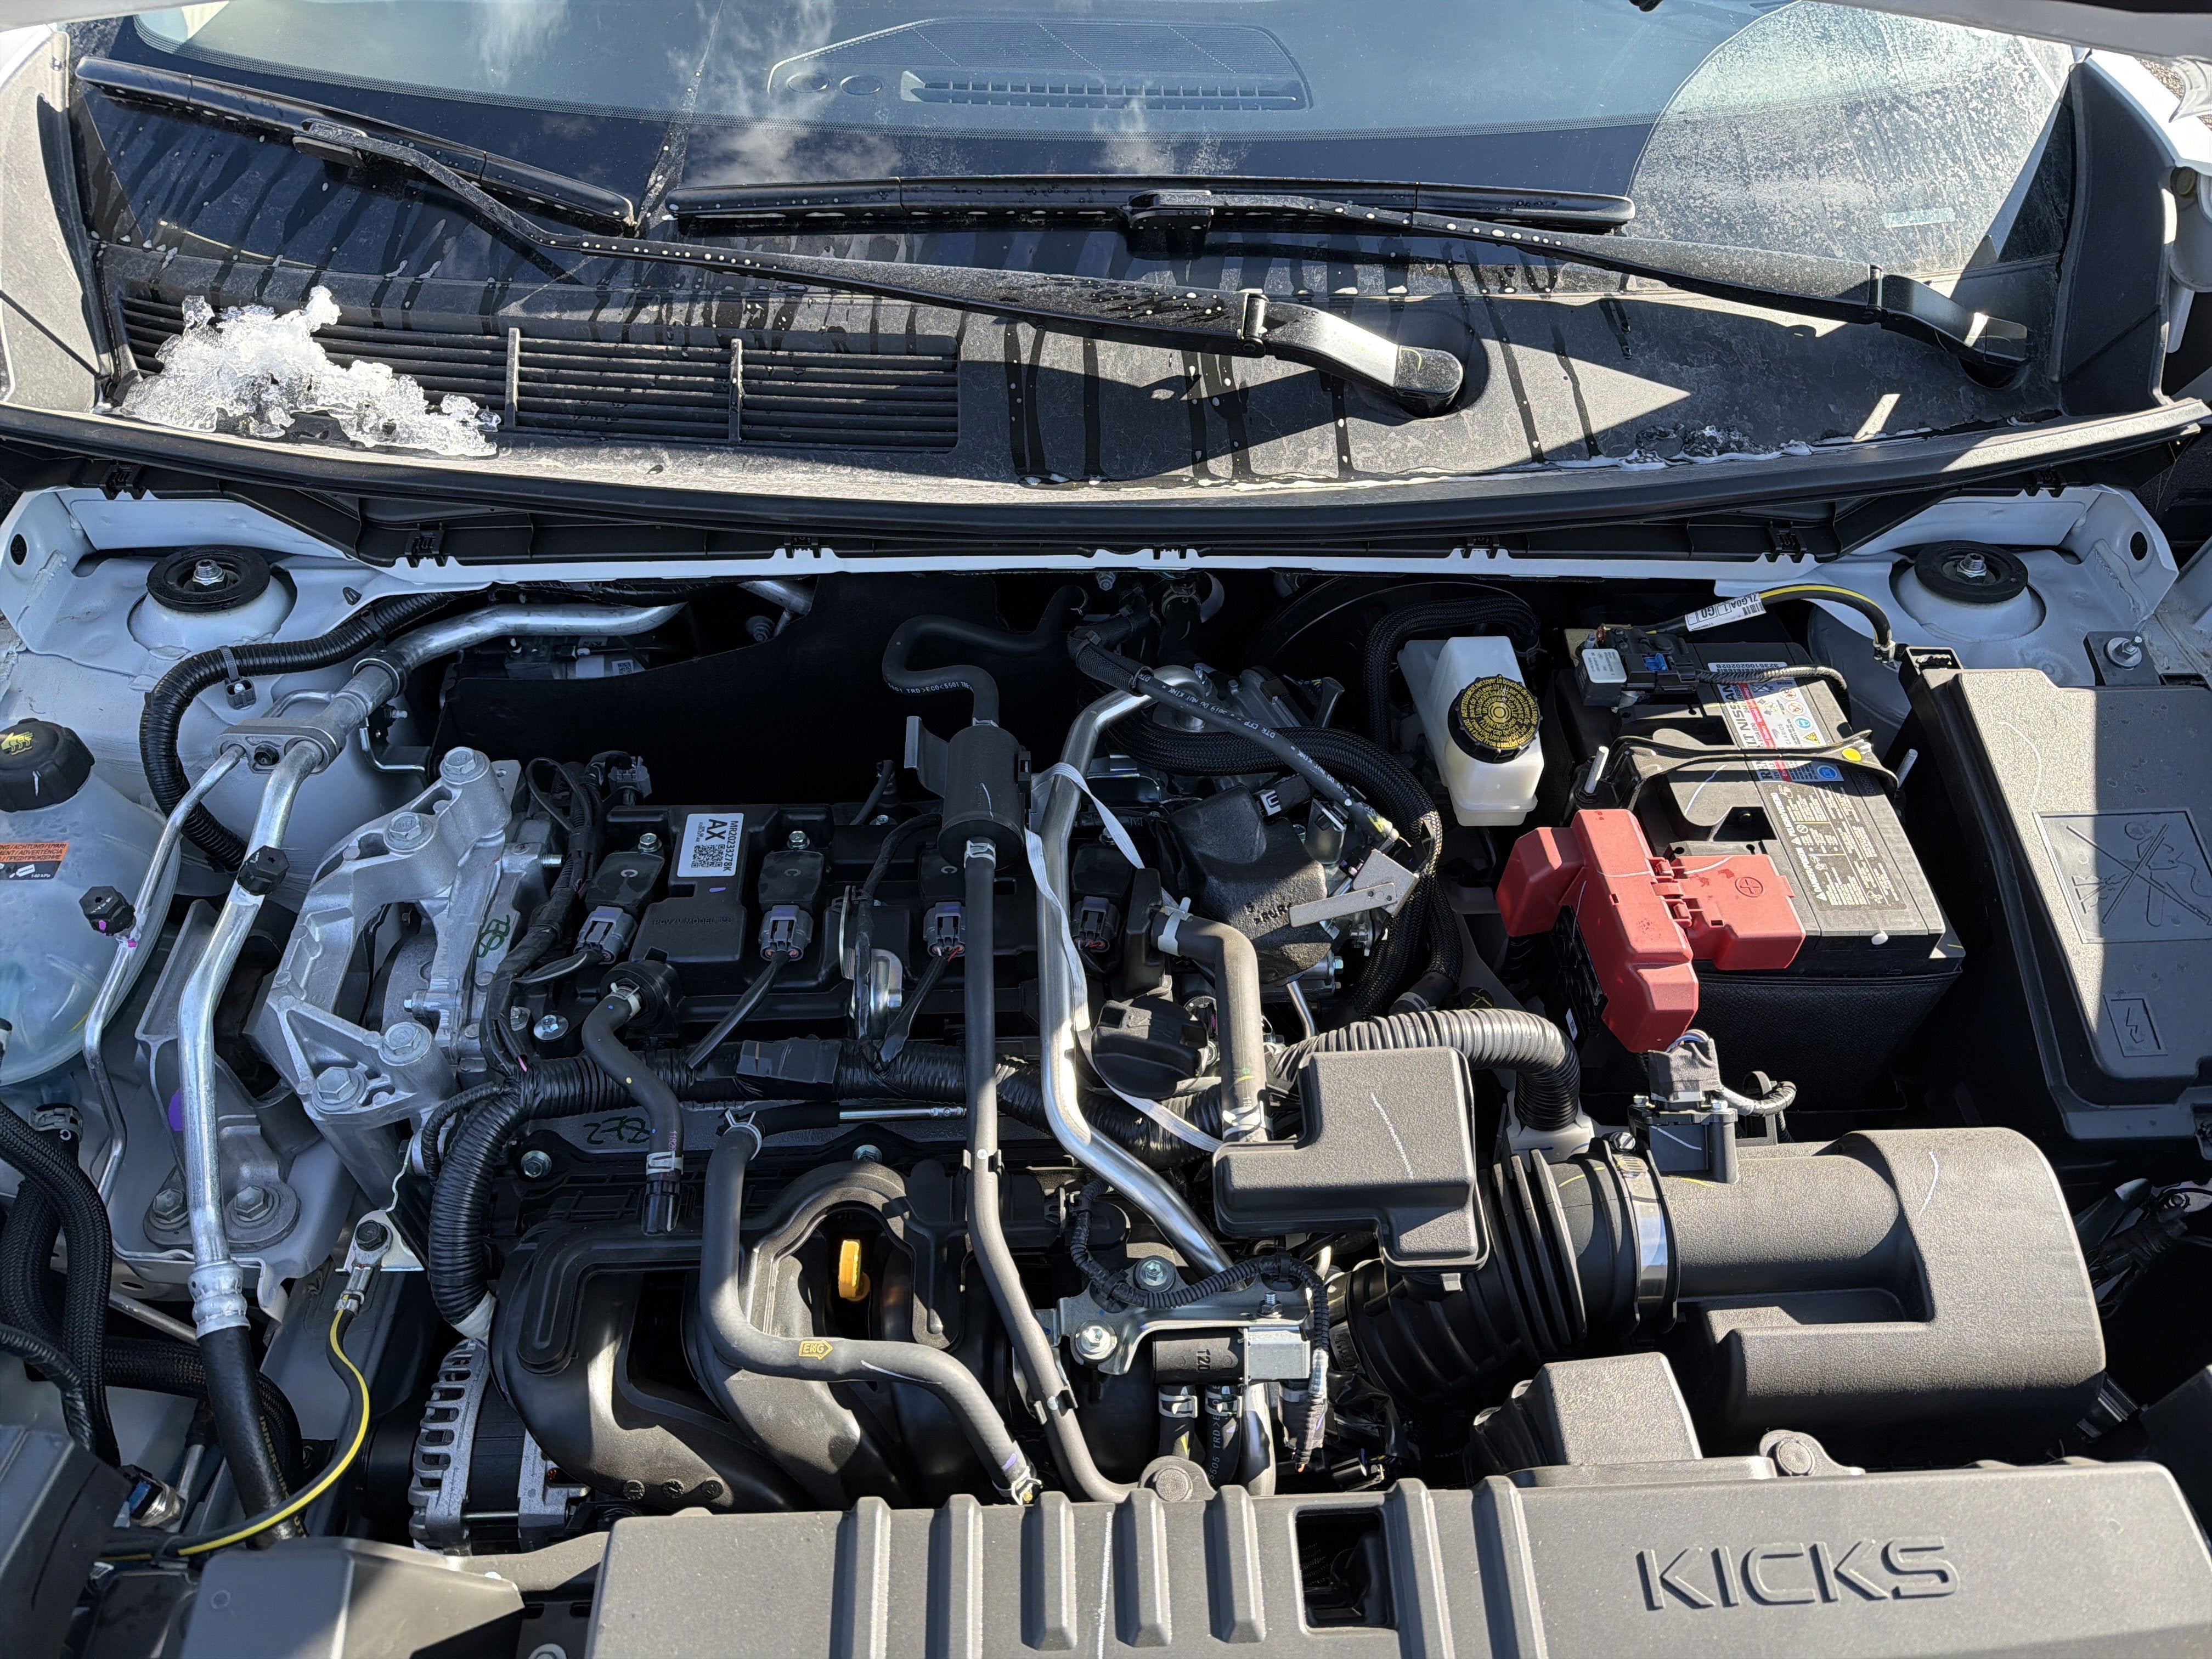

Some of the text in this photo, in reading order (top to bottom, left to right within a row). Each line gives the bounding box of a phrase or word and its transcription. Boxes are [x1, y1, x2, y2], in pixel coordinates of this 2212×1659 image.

[1244, 720, 1277, 739] DTR CFP
[705, 819, 728, 841] AX
[723, 820, 739, 872] MR20233278K
[803, 1344, 825, 1353] ENG
[1635, 1537, 1960, 1611] KICKS
